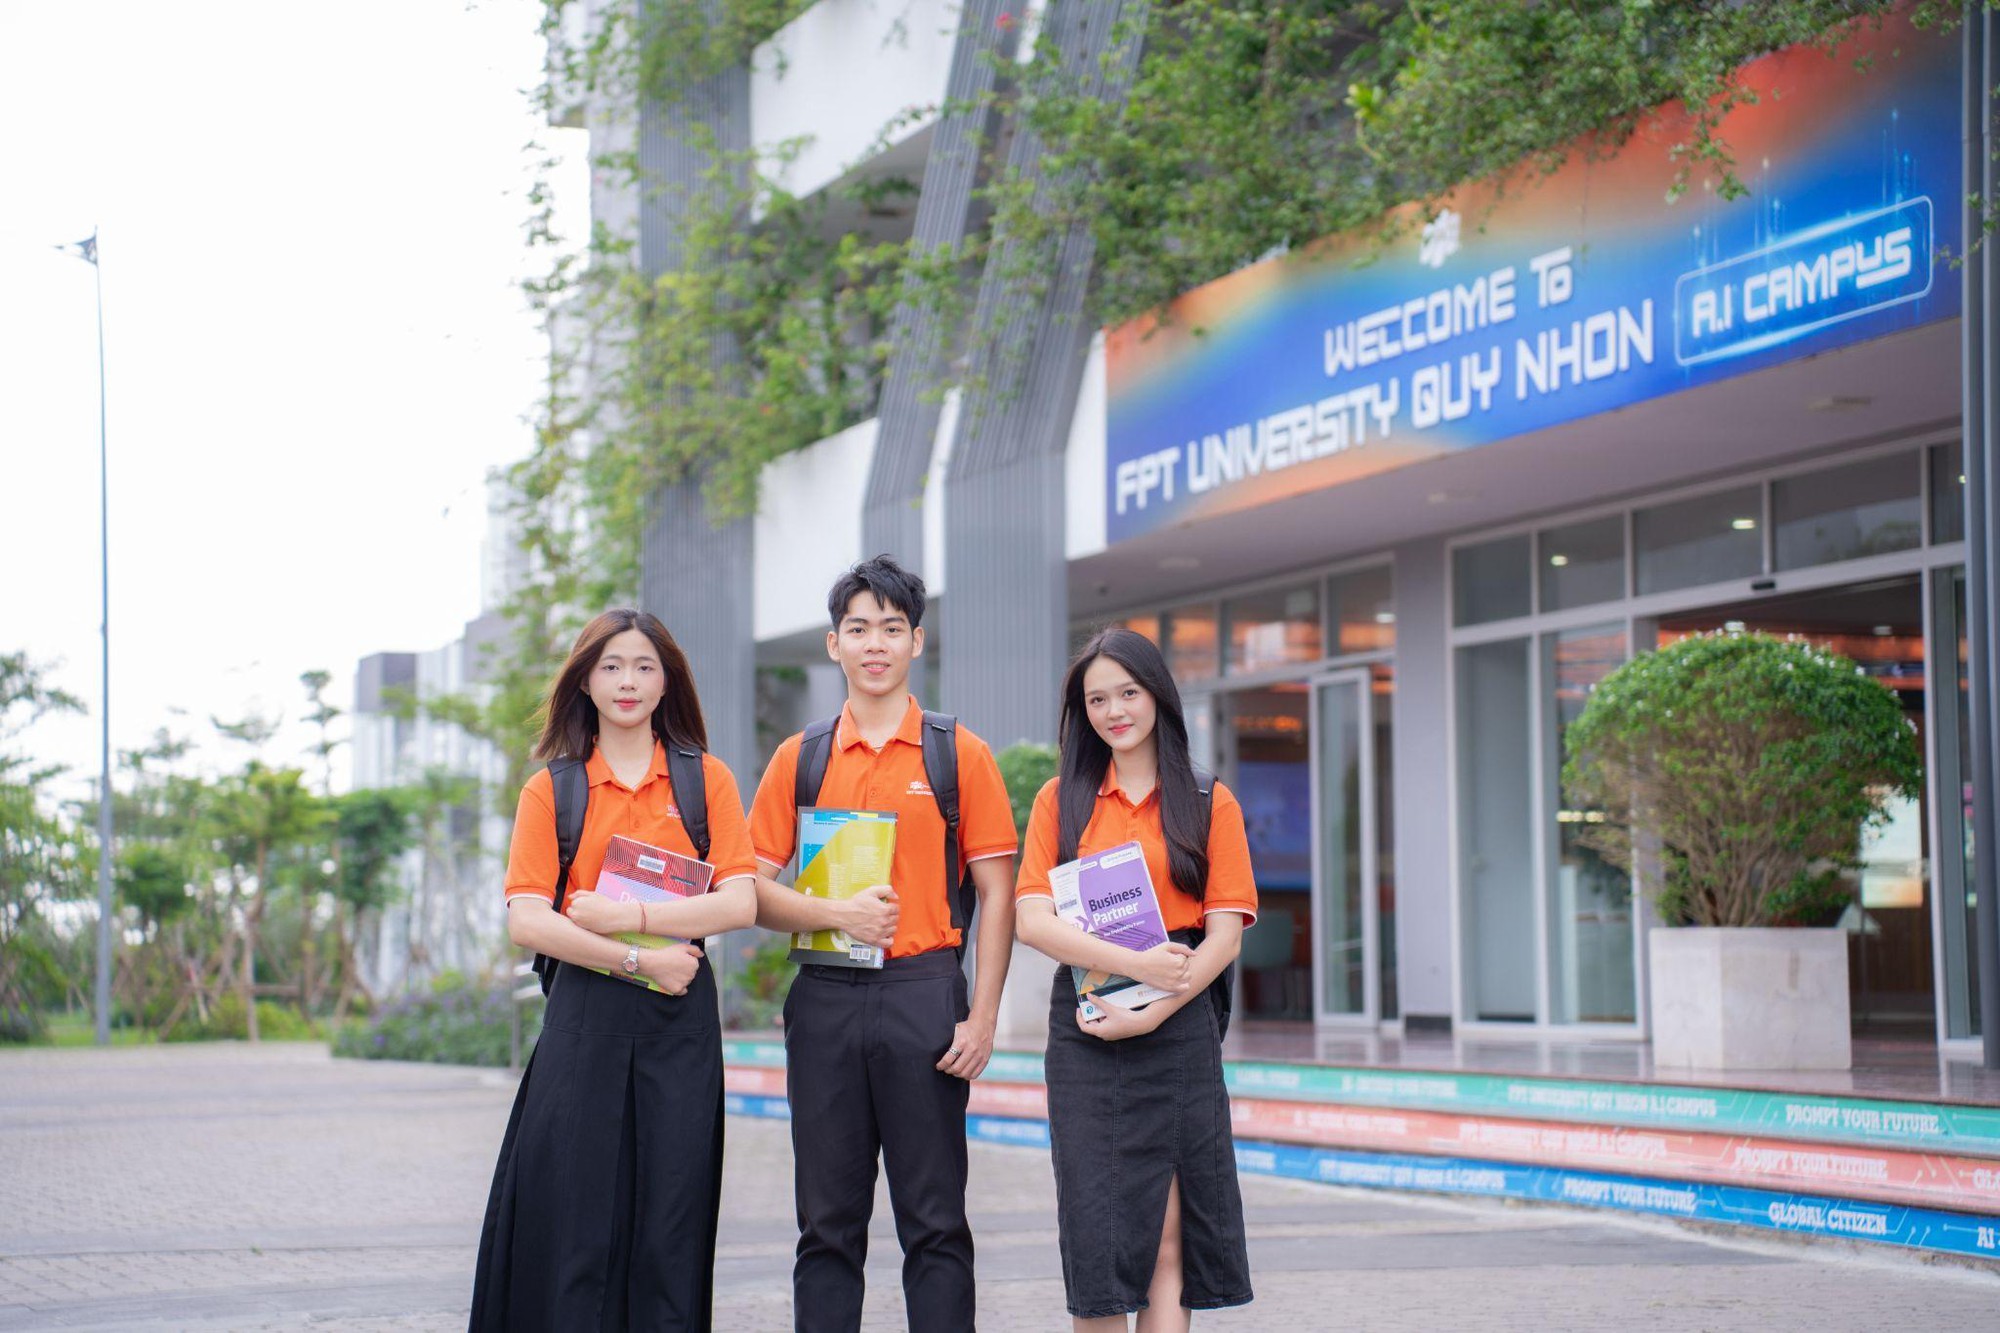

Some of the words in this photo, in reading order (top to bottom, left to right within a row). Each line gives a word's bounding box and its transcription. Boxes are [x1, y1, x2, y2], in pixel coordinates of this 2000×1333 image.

[1692, 283, 1733, 338] A.I
[1743, 226, 1912, 323] CAMPUS
[1324, 265, 1516, 377] WELCOME
[1116, 446, 1181, 515] FPT
[1187, 377, 1399, 494] UNIVERSITY
[1411, 346, 1502, 430] QUY
[1516, 298, 1654, 400] NHON
[1088, 886, 1142, 912] Business
[1092, 902, 1139, 926] Partner
[1785, 1103, 1840, 1127] PROMPT
[1841, 1108, 1882, 1129] YOUR
[1882, 1111, 1940, 1134] FUTURE
[1828, 1155, 1888, 1180] FUTURE
[1564, 1177, 1611, 1202] PROMPT
[1611, 1183, 1646, 1207] YOUR
[1646, 1187, 1696, 1212] FUTURE
[1768, 1201, 1826, 1228] GLOBAL
[1827, 1209, 1887, 1235] CITIZEN
